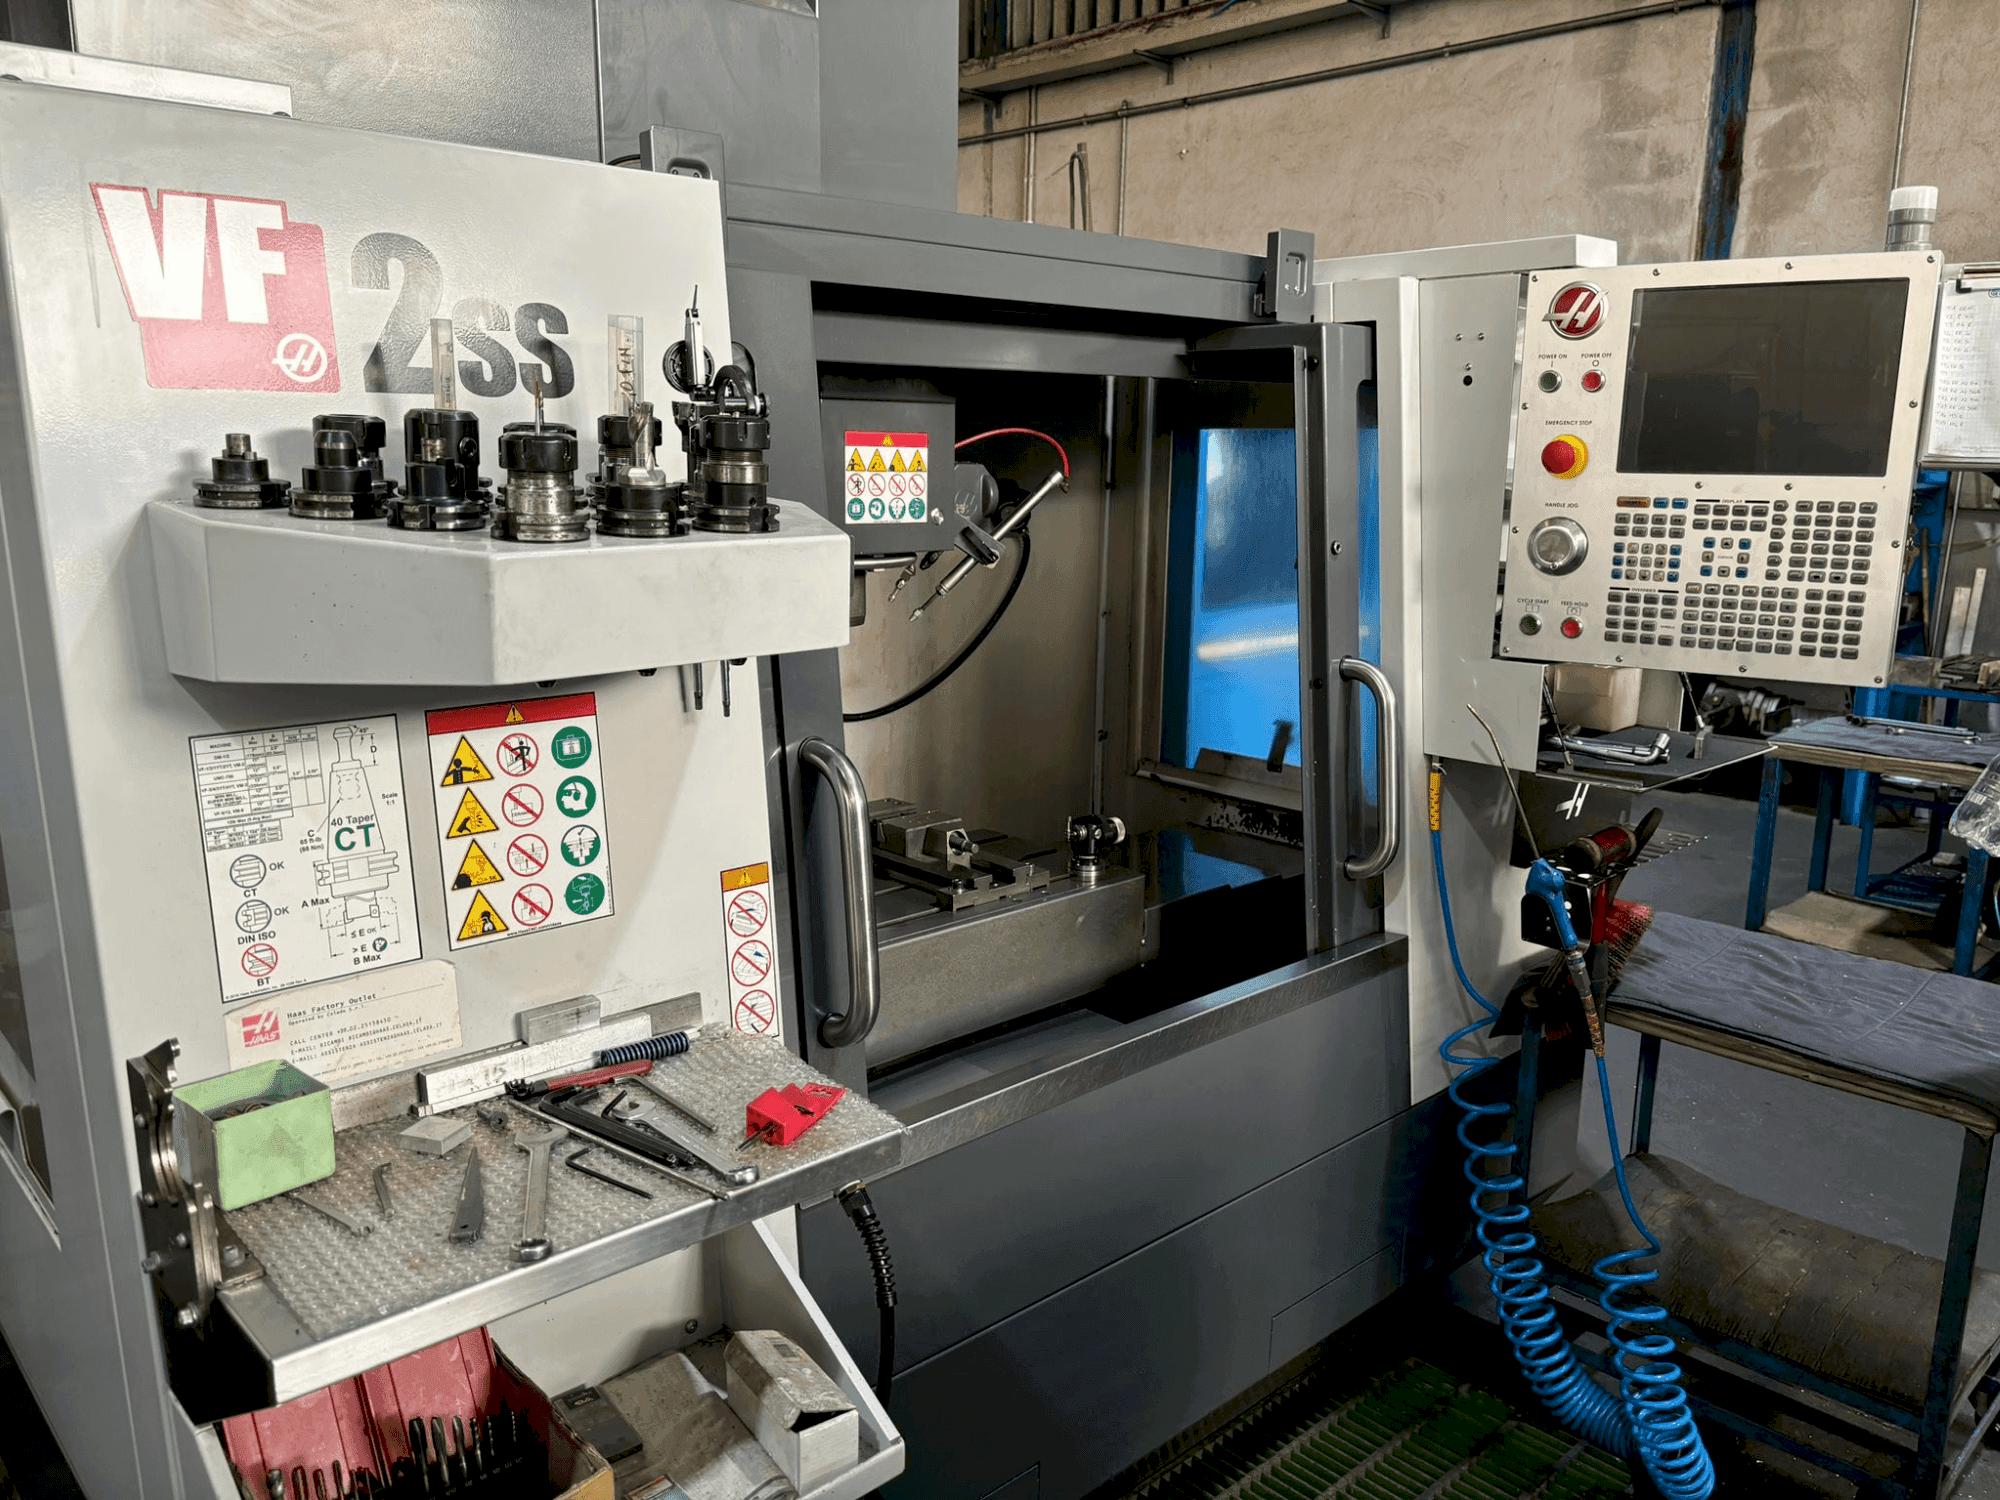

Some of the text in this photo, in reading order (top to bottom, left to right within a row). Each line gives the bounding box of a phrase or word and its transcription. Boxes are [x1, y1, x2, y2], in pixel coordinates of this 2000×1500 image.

[96, 187, 287, 324] VF
[1516, 596, 1534, 604] CYCLE
[370, 745, 377, 753] D
[381, 791, 399, 800] Scale
[331, 813, 375, 827] 40 Taper
[307, 829, 315, 838] C
[334, 823, 376, 852] CT
[269, 861, 285, 871] OK
[243, 887, 258, 899] CT
[301, 896, 331, 909] A Max
[274, 906, 290, 916] OK
[237, 930, 276, 945] DIN ISO
[358, 928, 366, 937] E
[366, 926, 378, 934] OK
[360, 943, 368, 953] E
[353, 953, 383, 966] B Max
[257, 976, 271, 987] BT
[288, 992, 377, 1019] Haas Factory Outlet
[288, 1014, 315, 1027] Operated
[326, 1008, 346, 1018] Celada
[289, 1038, 306, 1047] CALL
[309, 1030, 334, 1042] CENTER
[290, 1045, 316, 1056] E-MAIL:
[319, 1037, 345, 1048] RICAMBI
[292, 1054, 317, 1065] E-MAIL:
[320, 1043, 357, 1057] ASSISTENZA
